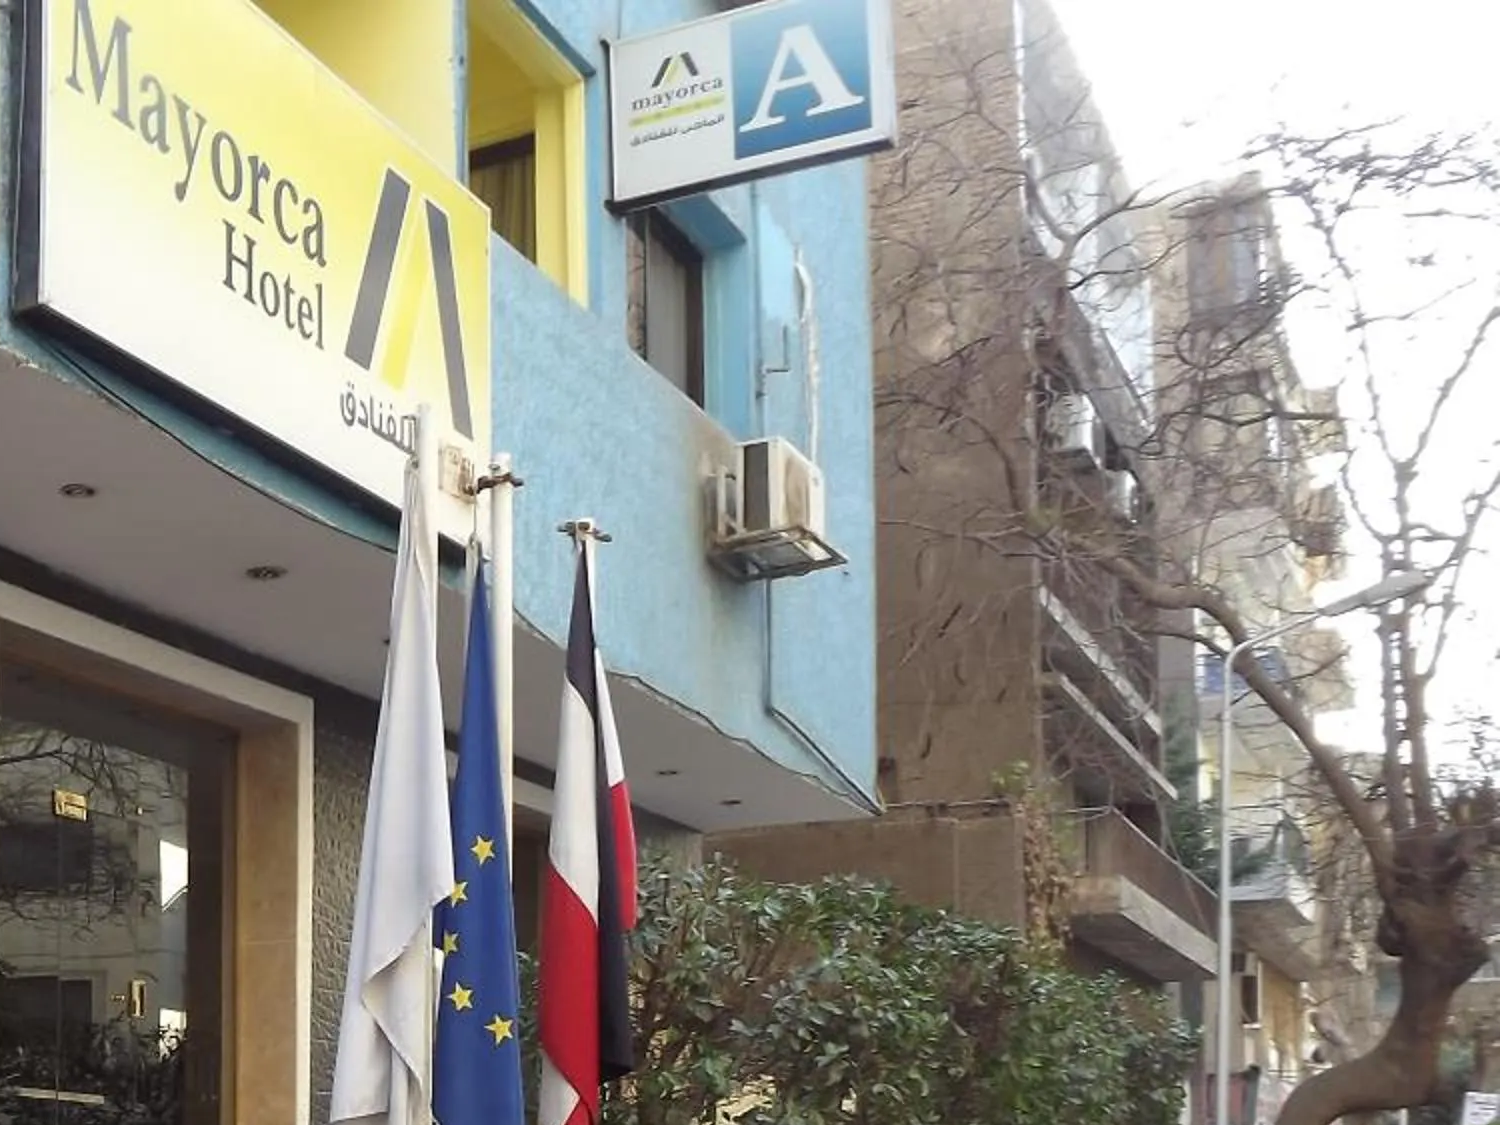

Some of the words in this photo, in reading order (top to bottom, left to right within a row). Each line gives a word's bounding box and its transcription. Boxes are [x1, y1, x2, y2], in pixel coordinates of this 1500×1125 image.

[64, 0, 328, 267] Mayorca
[631, 77, 724, 111] mayorca
[739, 23, 866, 133] A
[222, 218, 325, 350] Hotel
